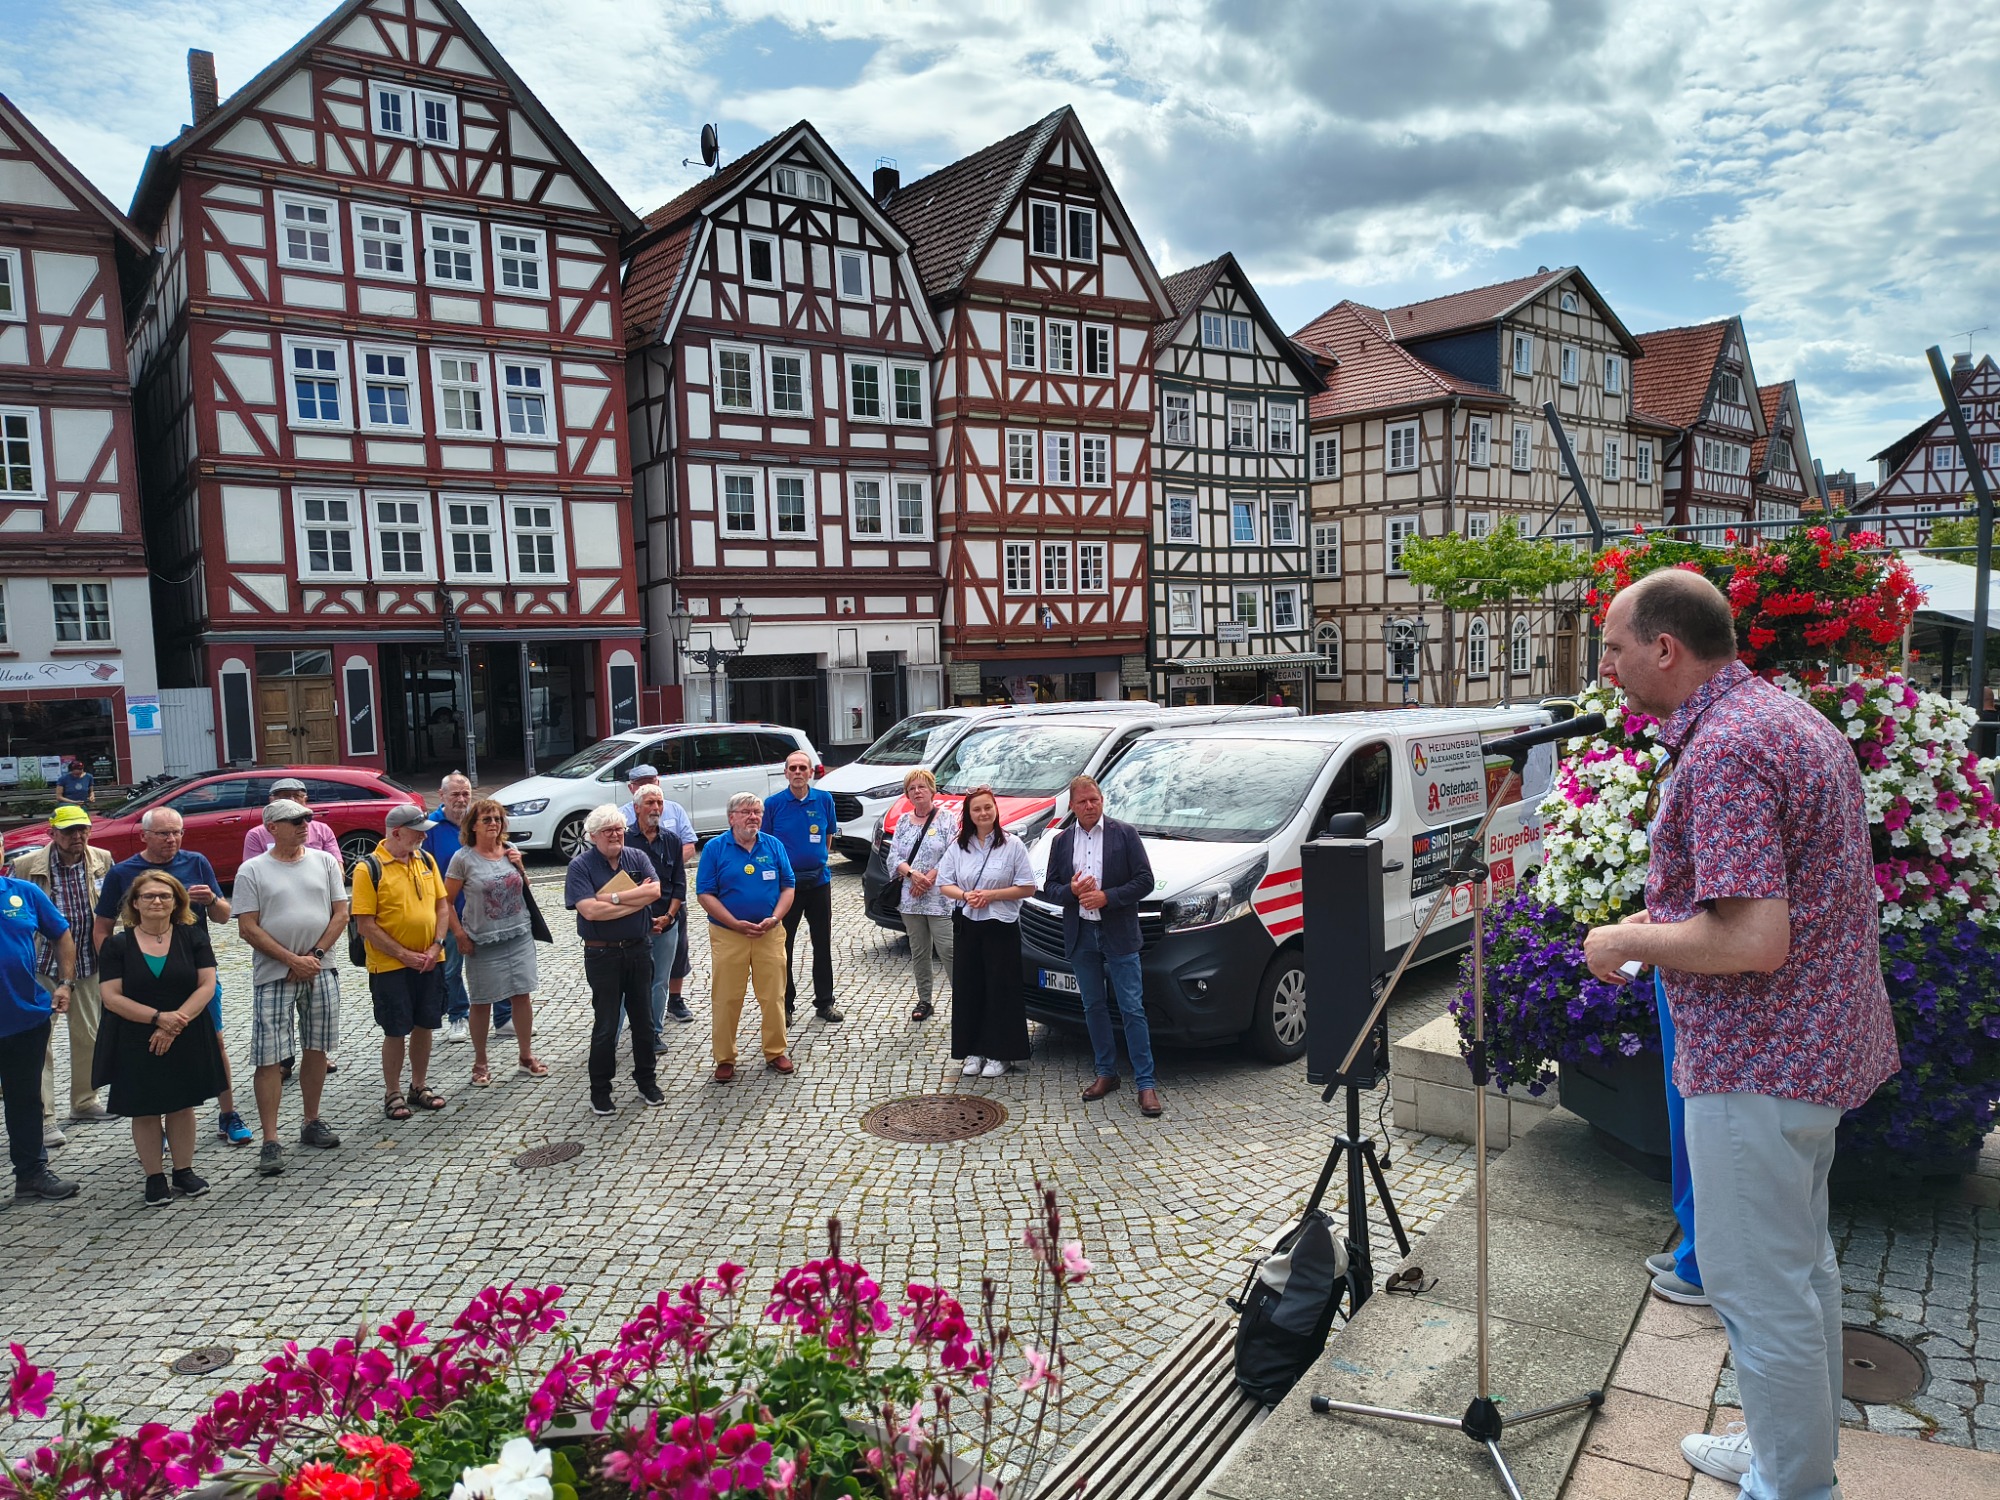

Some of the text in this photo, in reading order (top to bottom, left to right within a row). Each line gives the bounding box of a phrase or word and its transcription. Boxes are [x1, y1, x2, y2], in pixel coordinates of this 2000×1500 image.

[1185, 676, 1206, 686] FOTO
[1428, 739, 1479, 753] HEIZUNGSBAU
[1430, 753, 1464, 763] ALEXANDER
[1440, 778, 1479, 797] Osterbach
[1448, 792, 1480, 807] APOTHEKE
[1413, 838, 1430, 855] WIR
[1431, 833, 1449, 850] SIND
[1490, 826, 1540, 854] BürgerBus
[1413, 856, 1431, 868] DEINE
[1432, 849, 1450, 863] BANK.
[1045, 971, 1057, 987] HR
